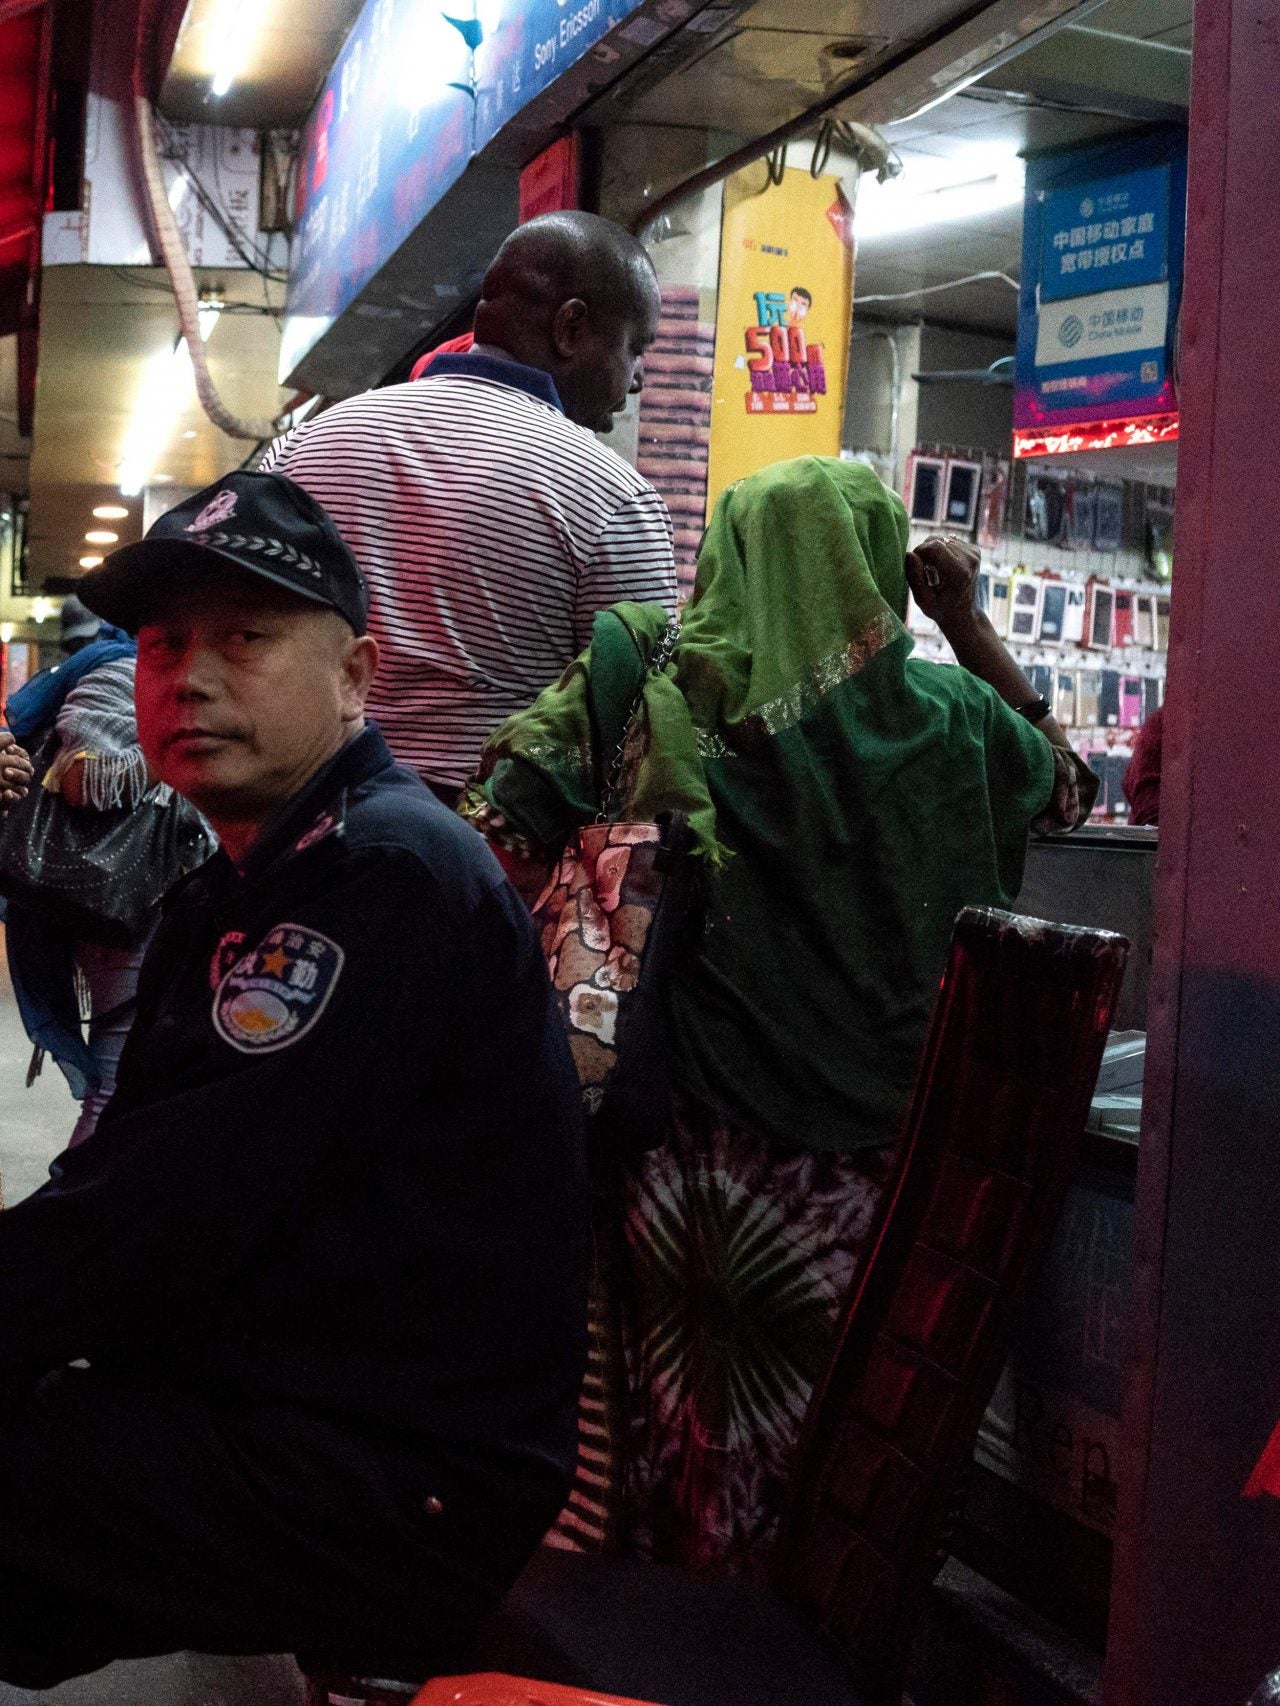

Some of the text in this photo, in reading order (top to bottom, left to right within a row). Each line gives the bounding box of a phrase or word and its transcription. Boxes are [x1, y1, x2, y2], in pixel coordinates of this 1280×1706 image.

[534, 0, 600, 70] Sony Ericsson
[1053, 212, 1155, 250] 中国移动家庭
[1060, 239, 1145, 274] 宽带授权点
[753, 290, 789, 327] 玩
[1088, 306, 1144, 327] 中国移动
